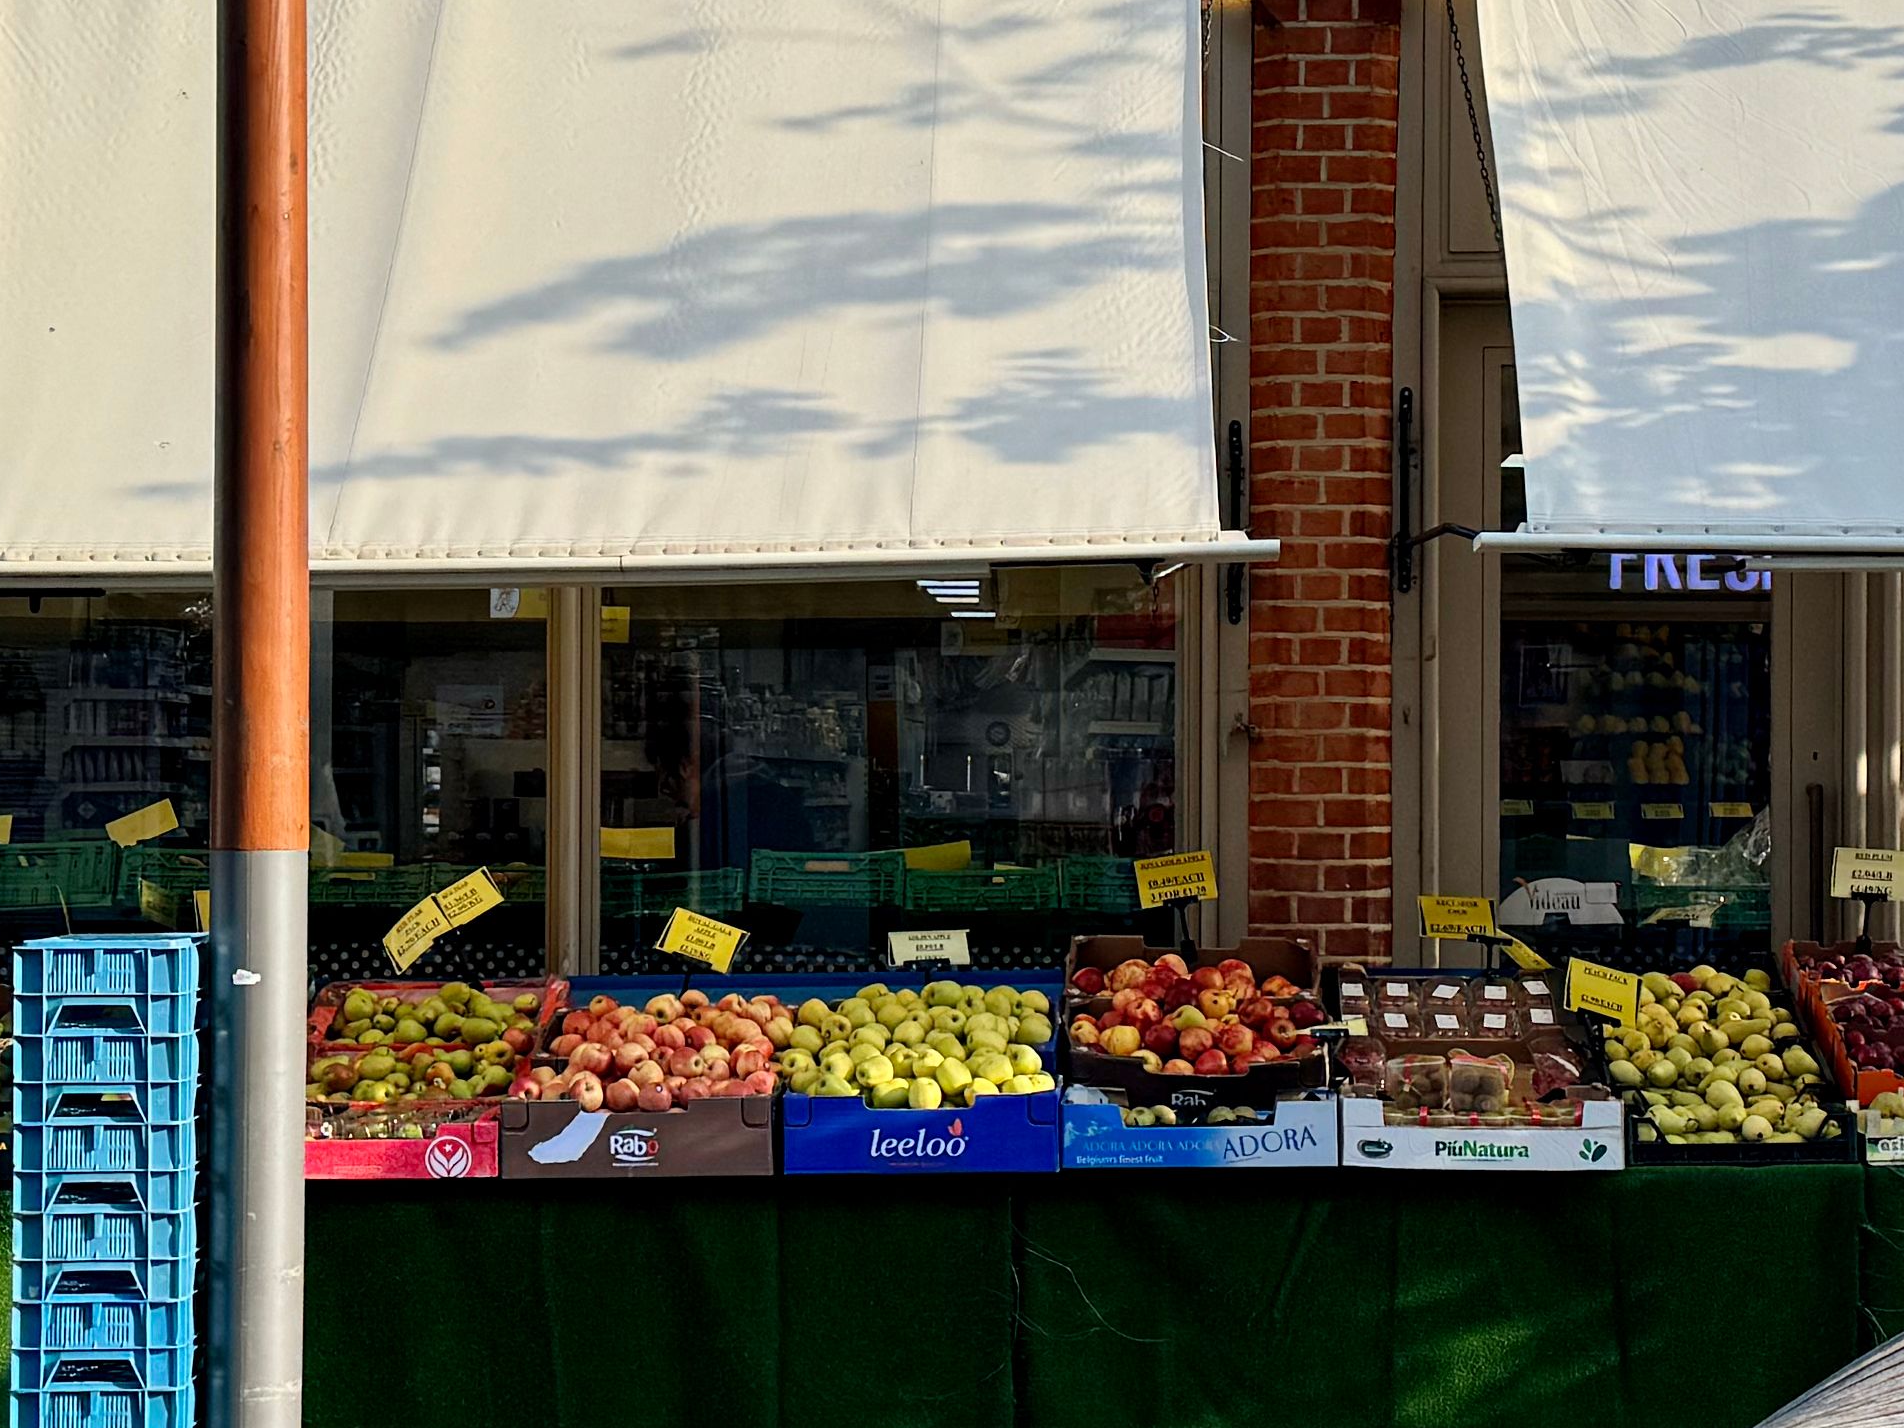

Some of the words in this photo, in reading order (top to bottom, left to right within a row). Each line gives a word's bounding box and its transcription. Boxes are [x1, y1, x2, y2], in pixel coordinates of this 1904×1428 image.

[609, 1134, 660, 1156] Rabo
[870, 1128, 967, 1158] leeloo
[1222, 1125, 1318, 1160] ADORA
